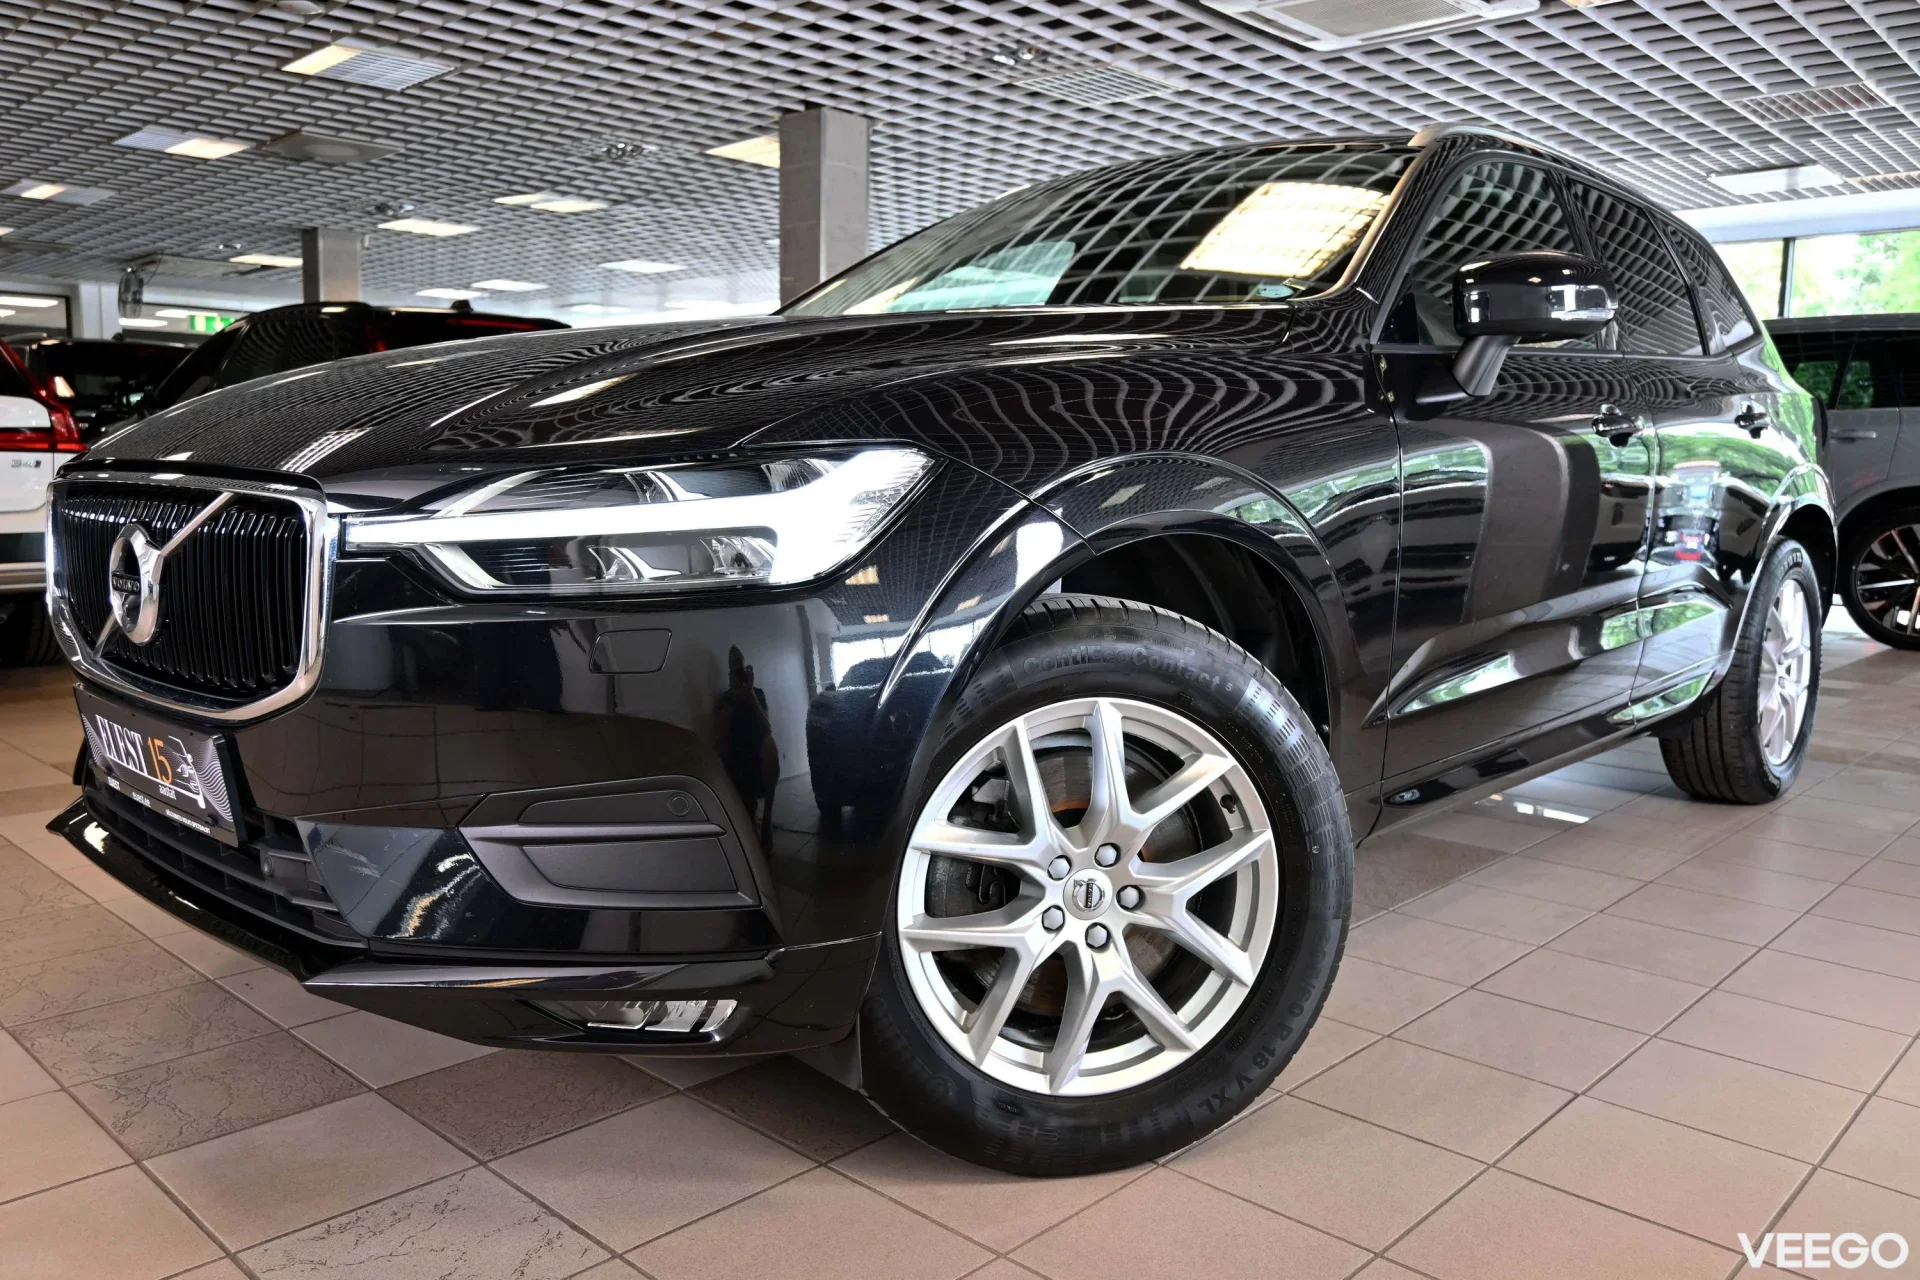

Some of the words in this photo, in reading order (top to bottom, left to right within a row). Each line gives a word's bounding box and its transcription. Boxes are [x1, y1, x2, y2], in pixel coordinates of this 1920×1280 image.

[112, 579, 140, 592] VOLVO
[1023, 645, 1220, 691] ContiEcoContact
[148, 736, 173, 785] 15
[1275, 1021, 1294, 1042] R
[1252, 1044, 1277, 1070] 18
[1234, 1071, 1254, 1092] V
[1198, 1086, 1234, 1114] XL
